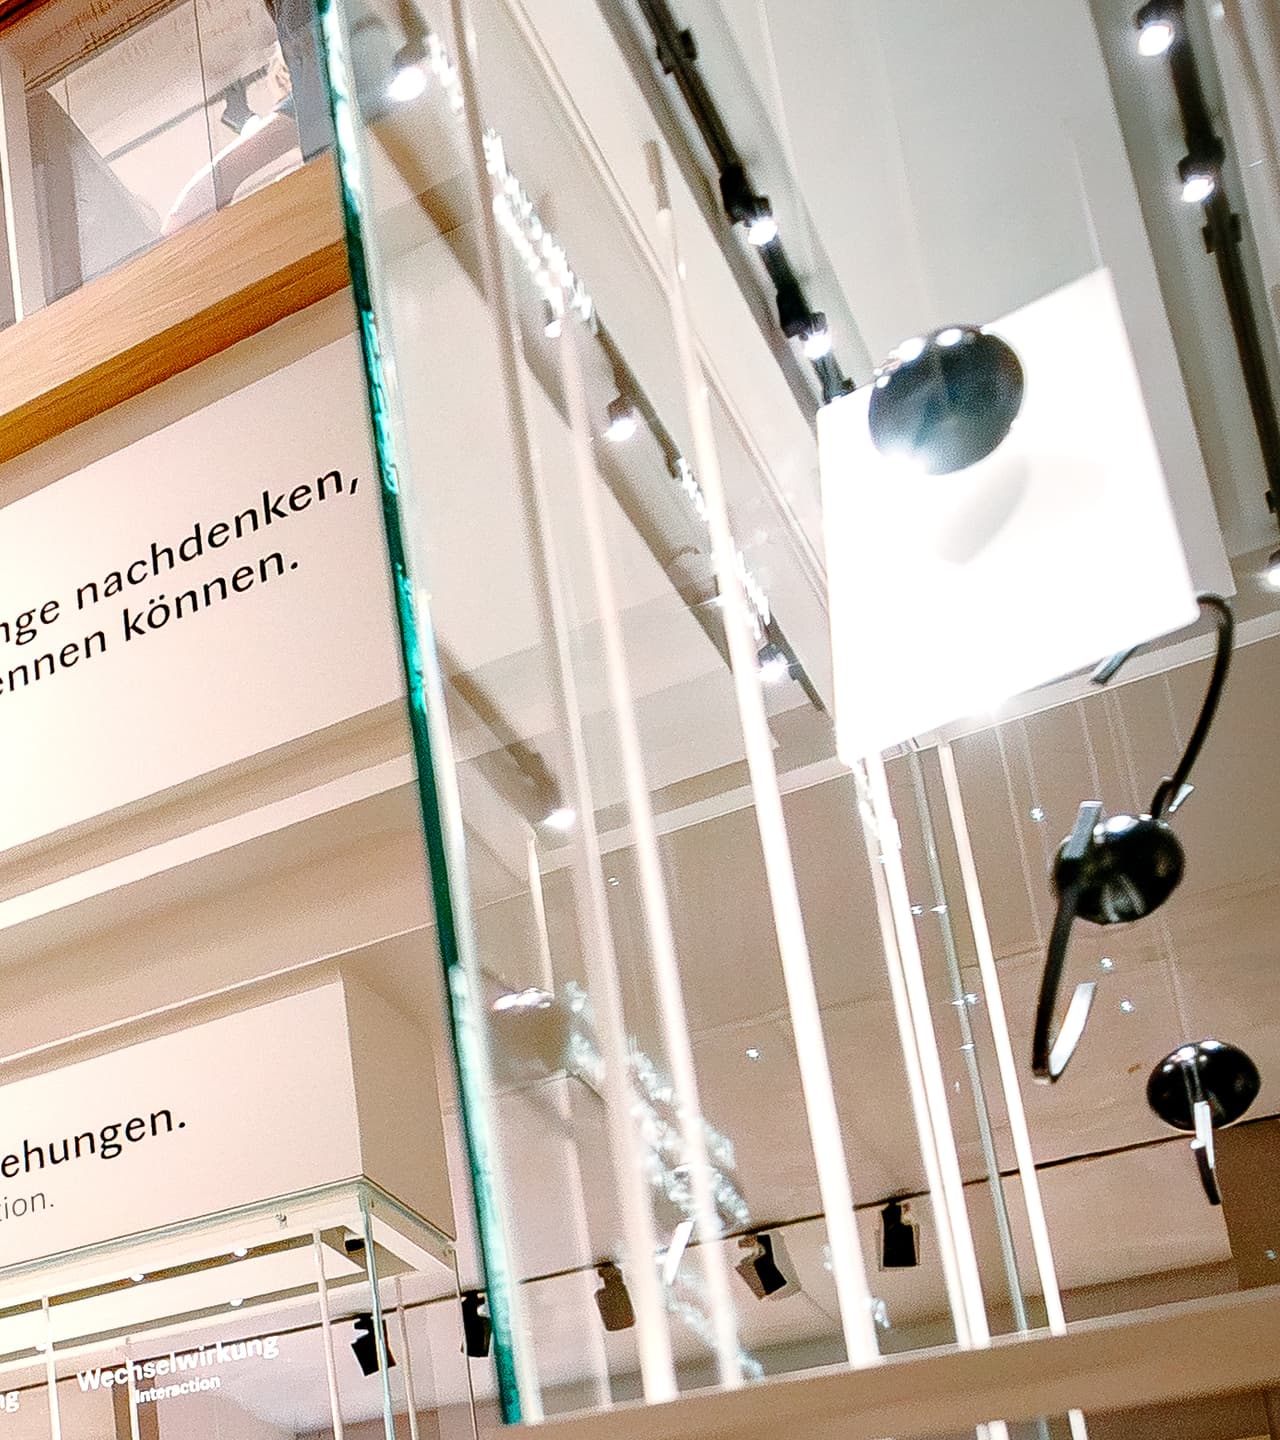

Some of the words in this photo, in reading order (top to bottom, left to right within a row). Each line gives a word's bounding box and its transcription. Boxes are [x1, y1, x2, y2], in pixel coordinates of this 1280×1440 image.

[73, 462, 362, 609] nachdenken,
[121, 553, 300, 643] können.
[77, 1334, 280, 1393] Wechselwirkung
[135, 1374, 222, 1405] Interaction
